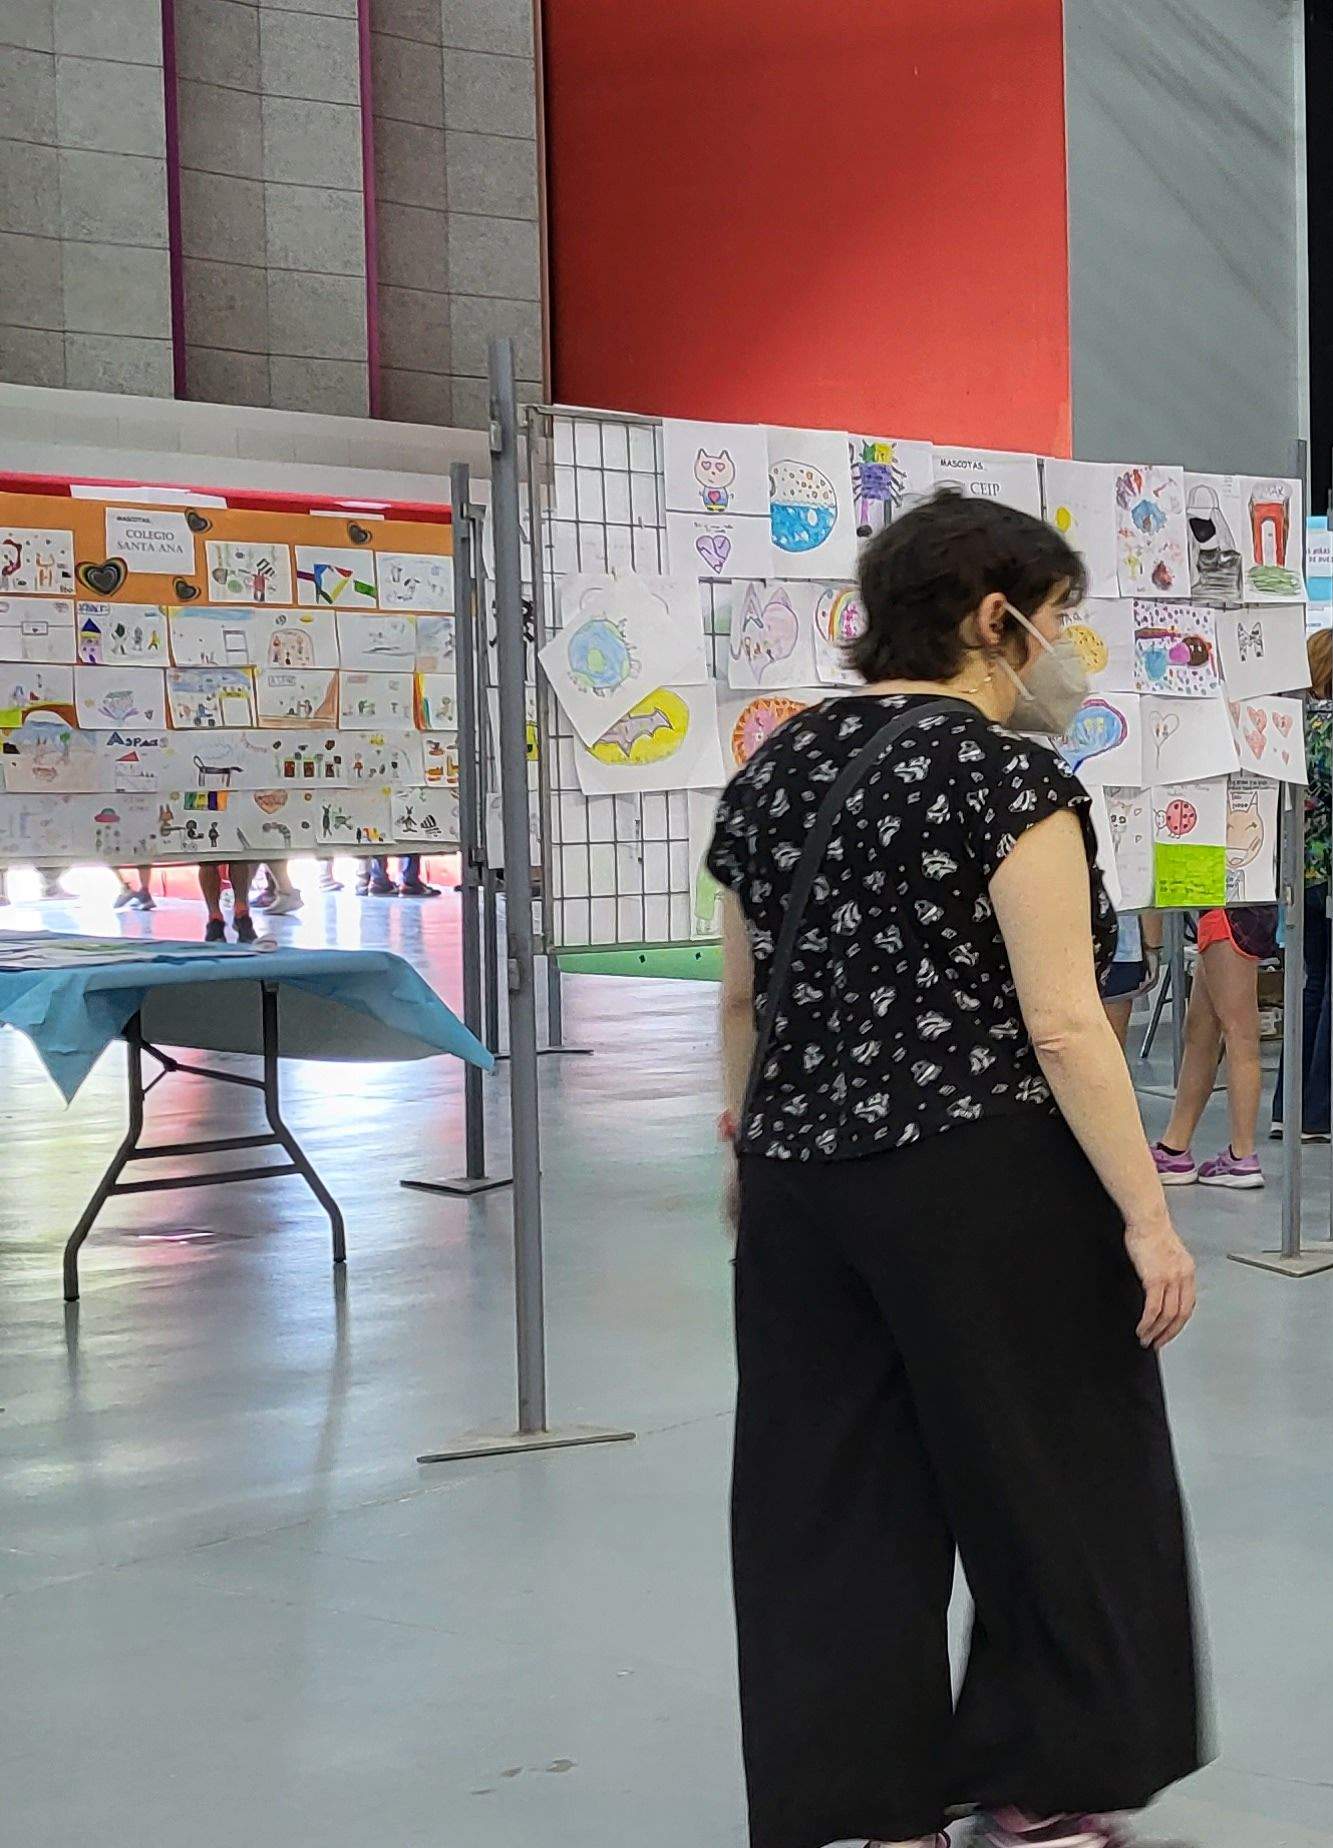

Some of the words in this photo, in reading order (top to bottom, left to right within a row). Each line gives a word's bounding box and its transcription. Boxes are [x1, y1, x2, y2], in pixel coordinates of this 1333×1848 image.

[969, 482, 1000, 496] CEIP
[126, 529, 175, 541] COLEGIO
[117, 541, 156, 553] SANTA
[159, 545, 184, 554] ANA
